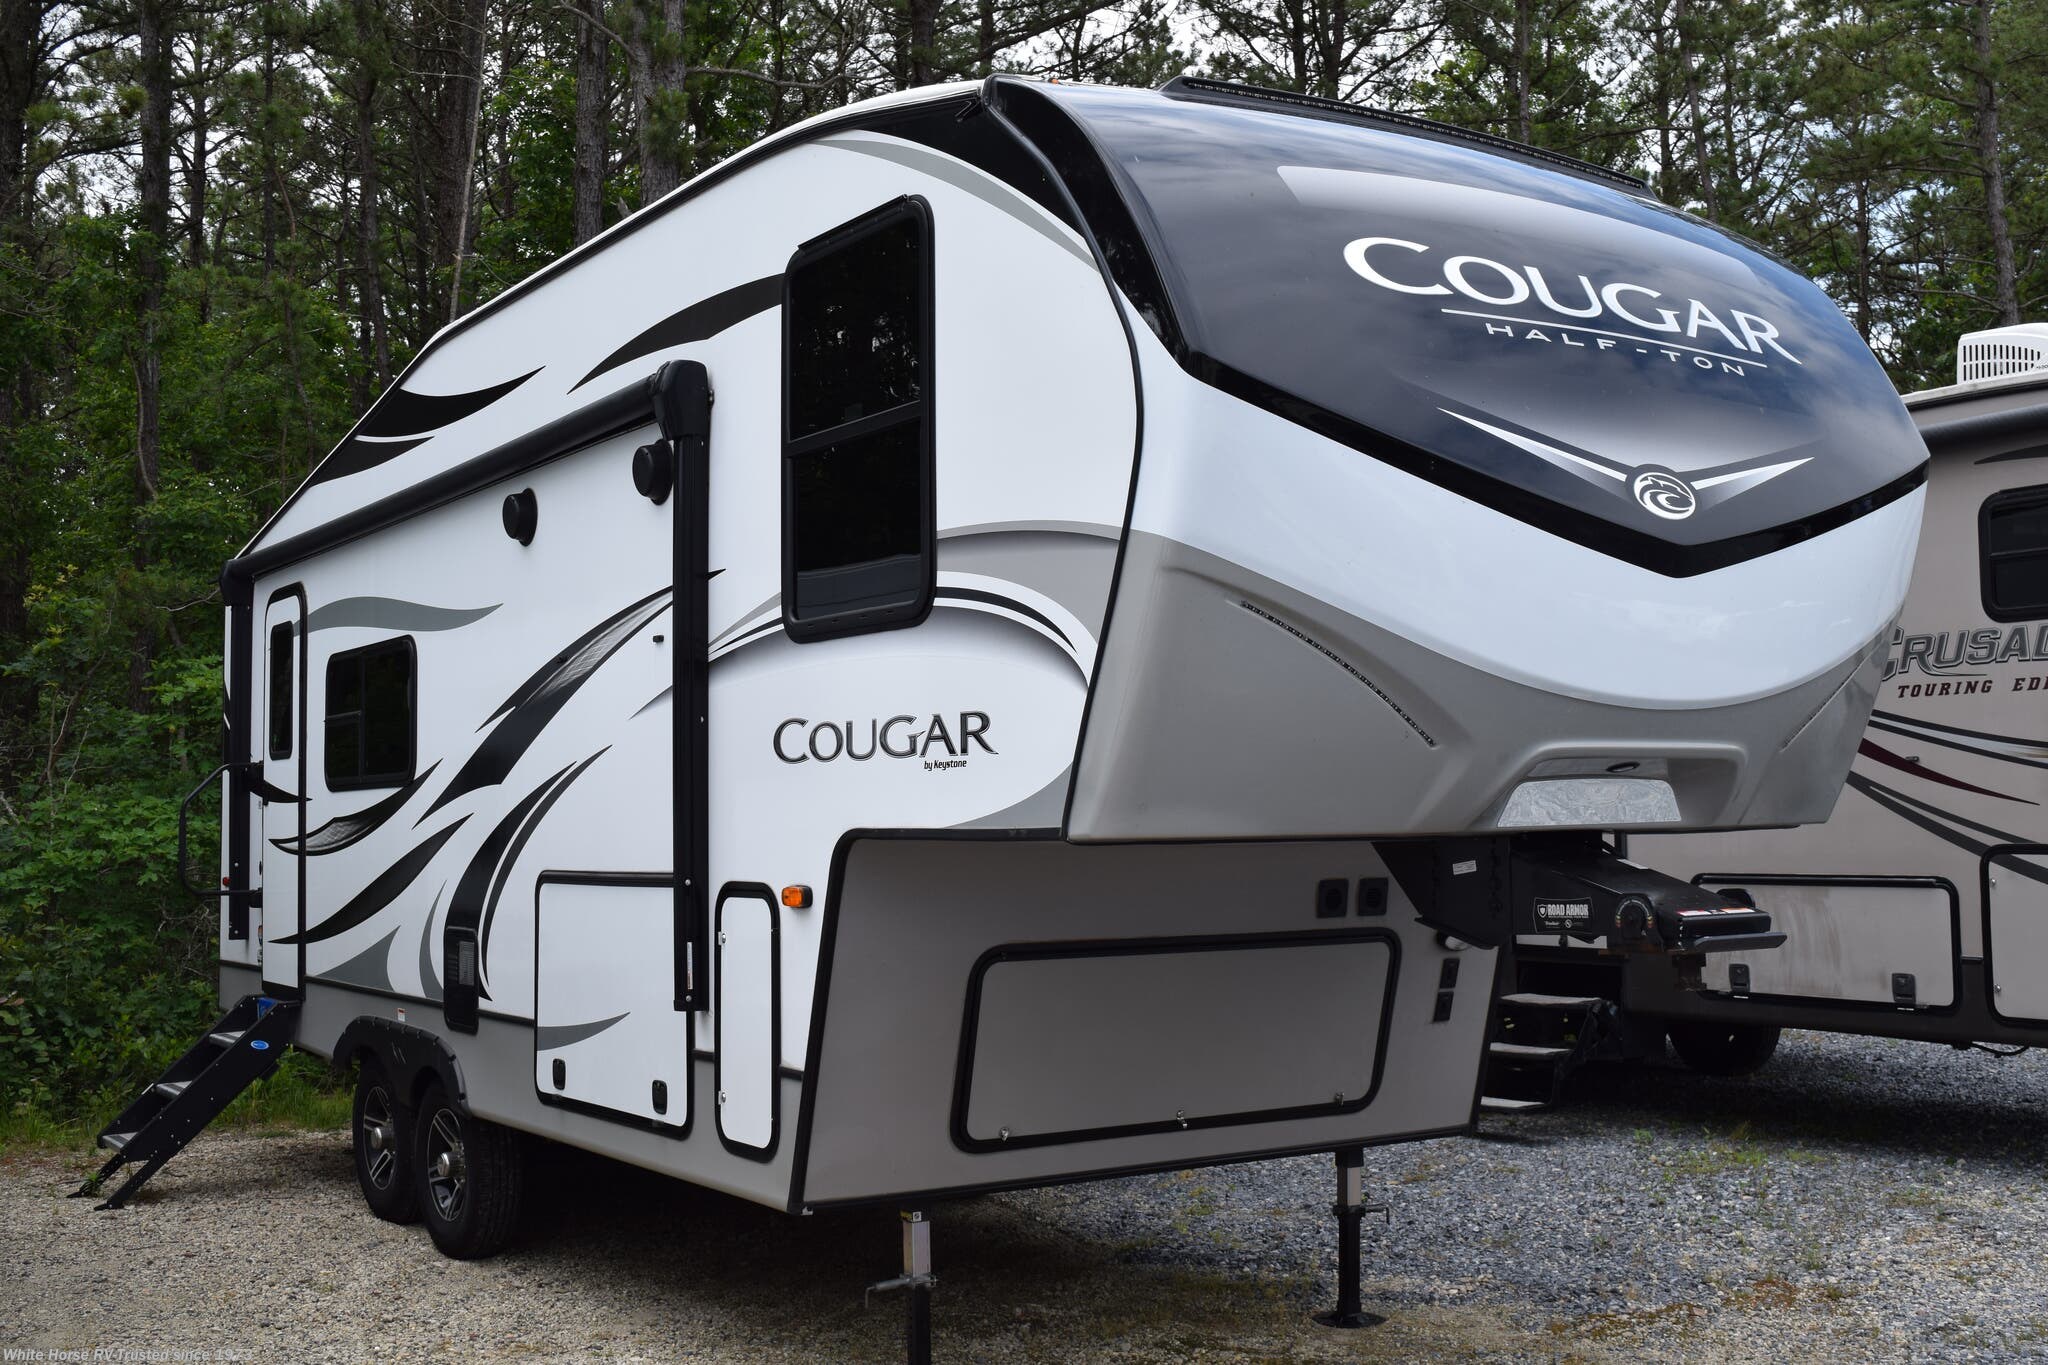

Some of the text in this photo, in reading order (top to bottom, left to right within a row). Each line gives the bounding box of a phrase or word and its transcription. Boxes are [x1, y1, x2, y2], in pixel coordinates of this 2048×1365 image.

[1343, 236, 1802, 365] COUGAR
[1485, 322, 1746, 377] HALF-TON
[1898, 679, 1994, 699] TOURING
[773, 710, 999, 765] COUGAR
[923, 760, 967, 771] by Keystone
[1547, 903, 1589, 916] ROAD ARMOR
